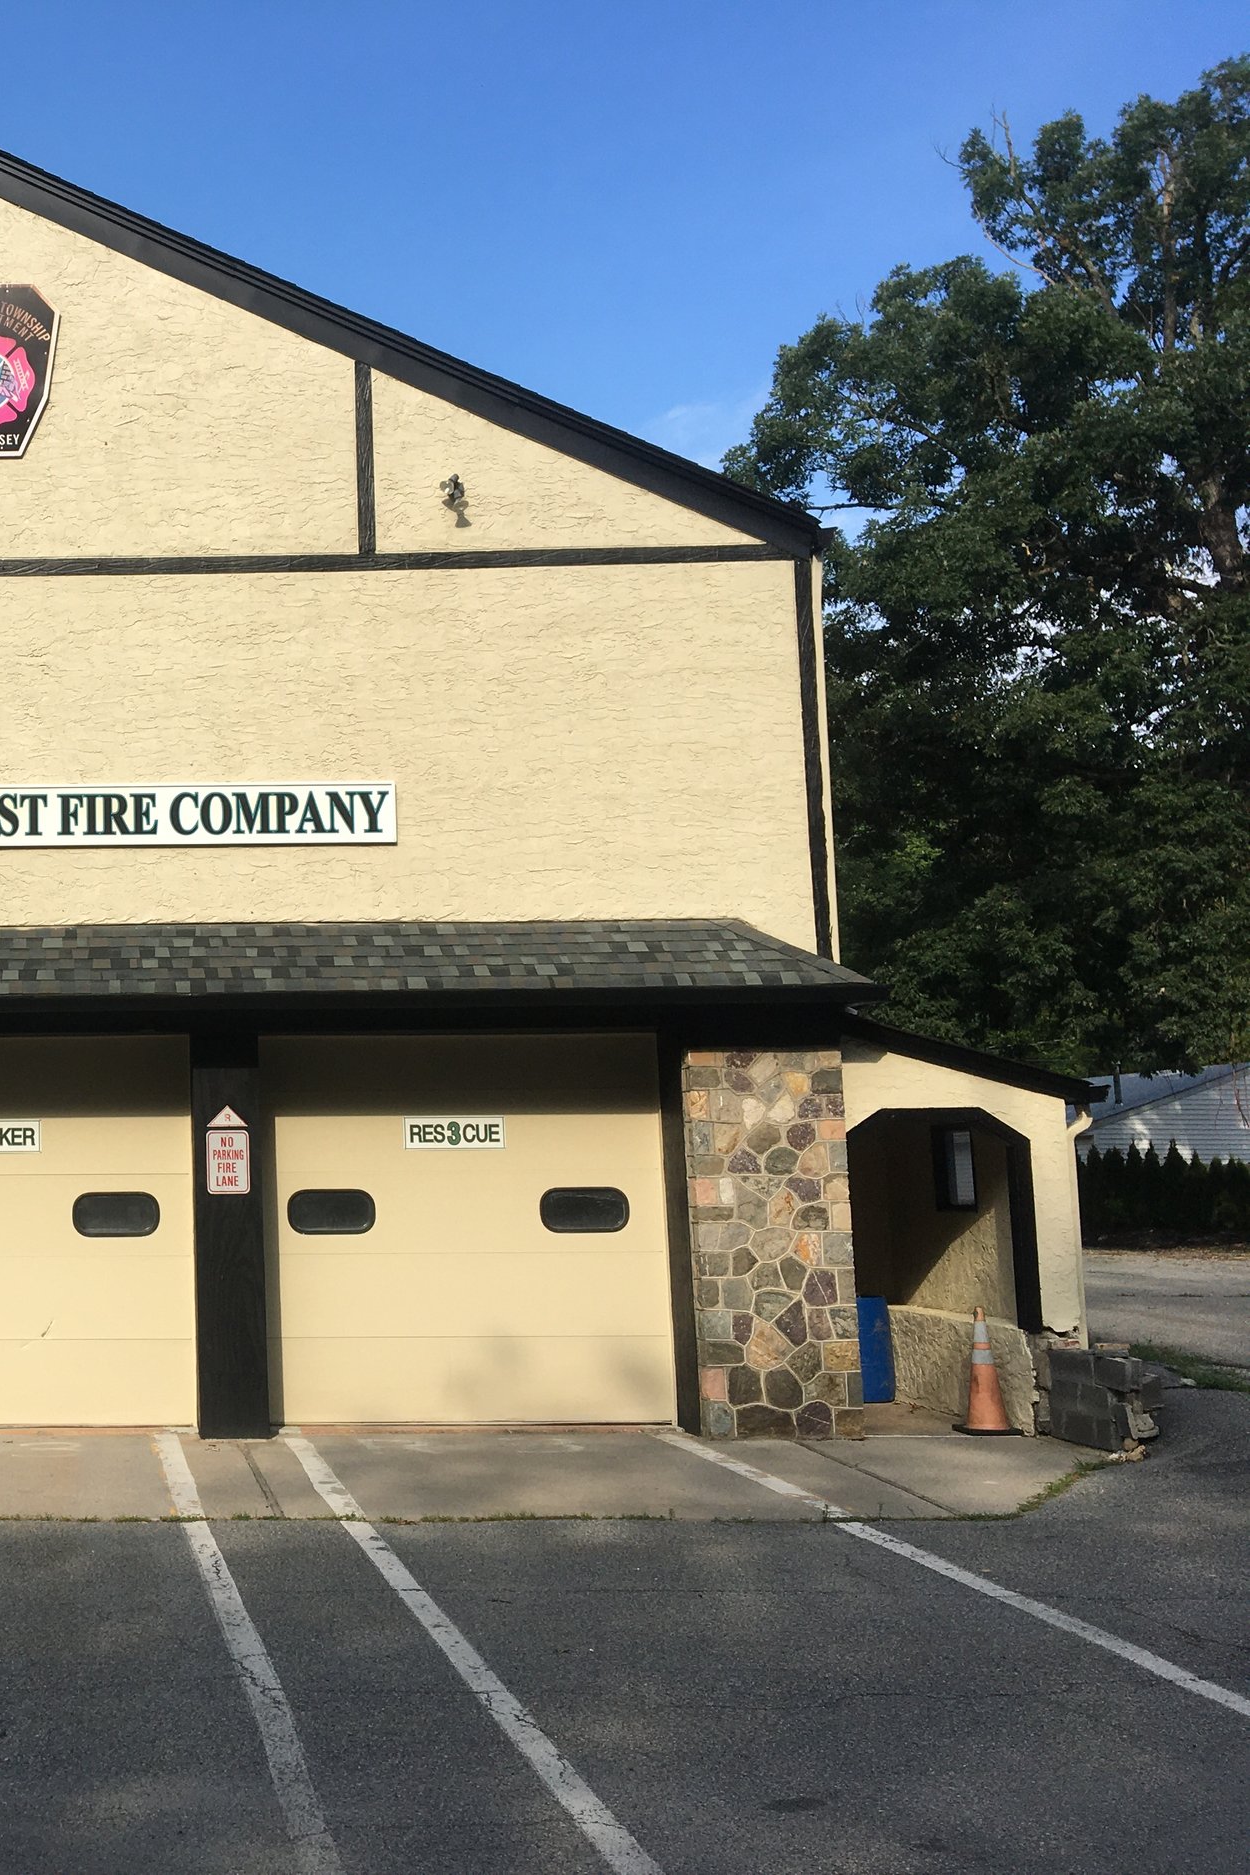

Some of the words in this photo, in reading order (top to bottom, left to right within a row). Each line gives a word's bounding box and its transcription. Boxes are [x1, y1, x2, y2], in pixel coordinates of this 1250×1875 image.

[0, 301, 51, 341] TOWNSHIP
[56, 793, 158, 836] FIRE
[169, 791, 389, 835] COMPANY
[220, 1136, 234, 1148] NO
[212, 1149, 244, 1160] PARKING
[217, 1162, 237, 1173] FIRE
[216, 1175, 239, 1187] LANE
